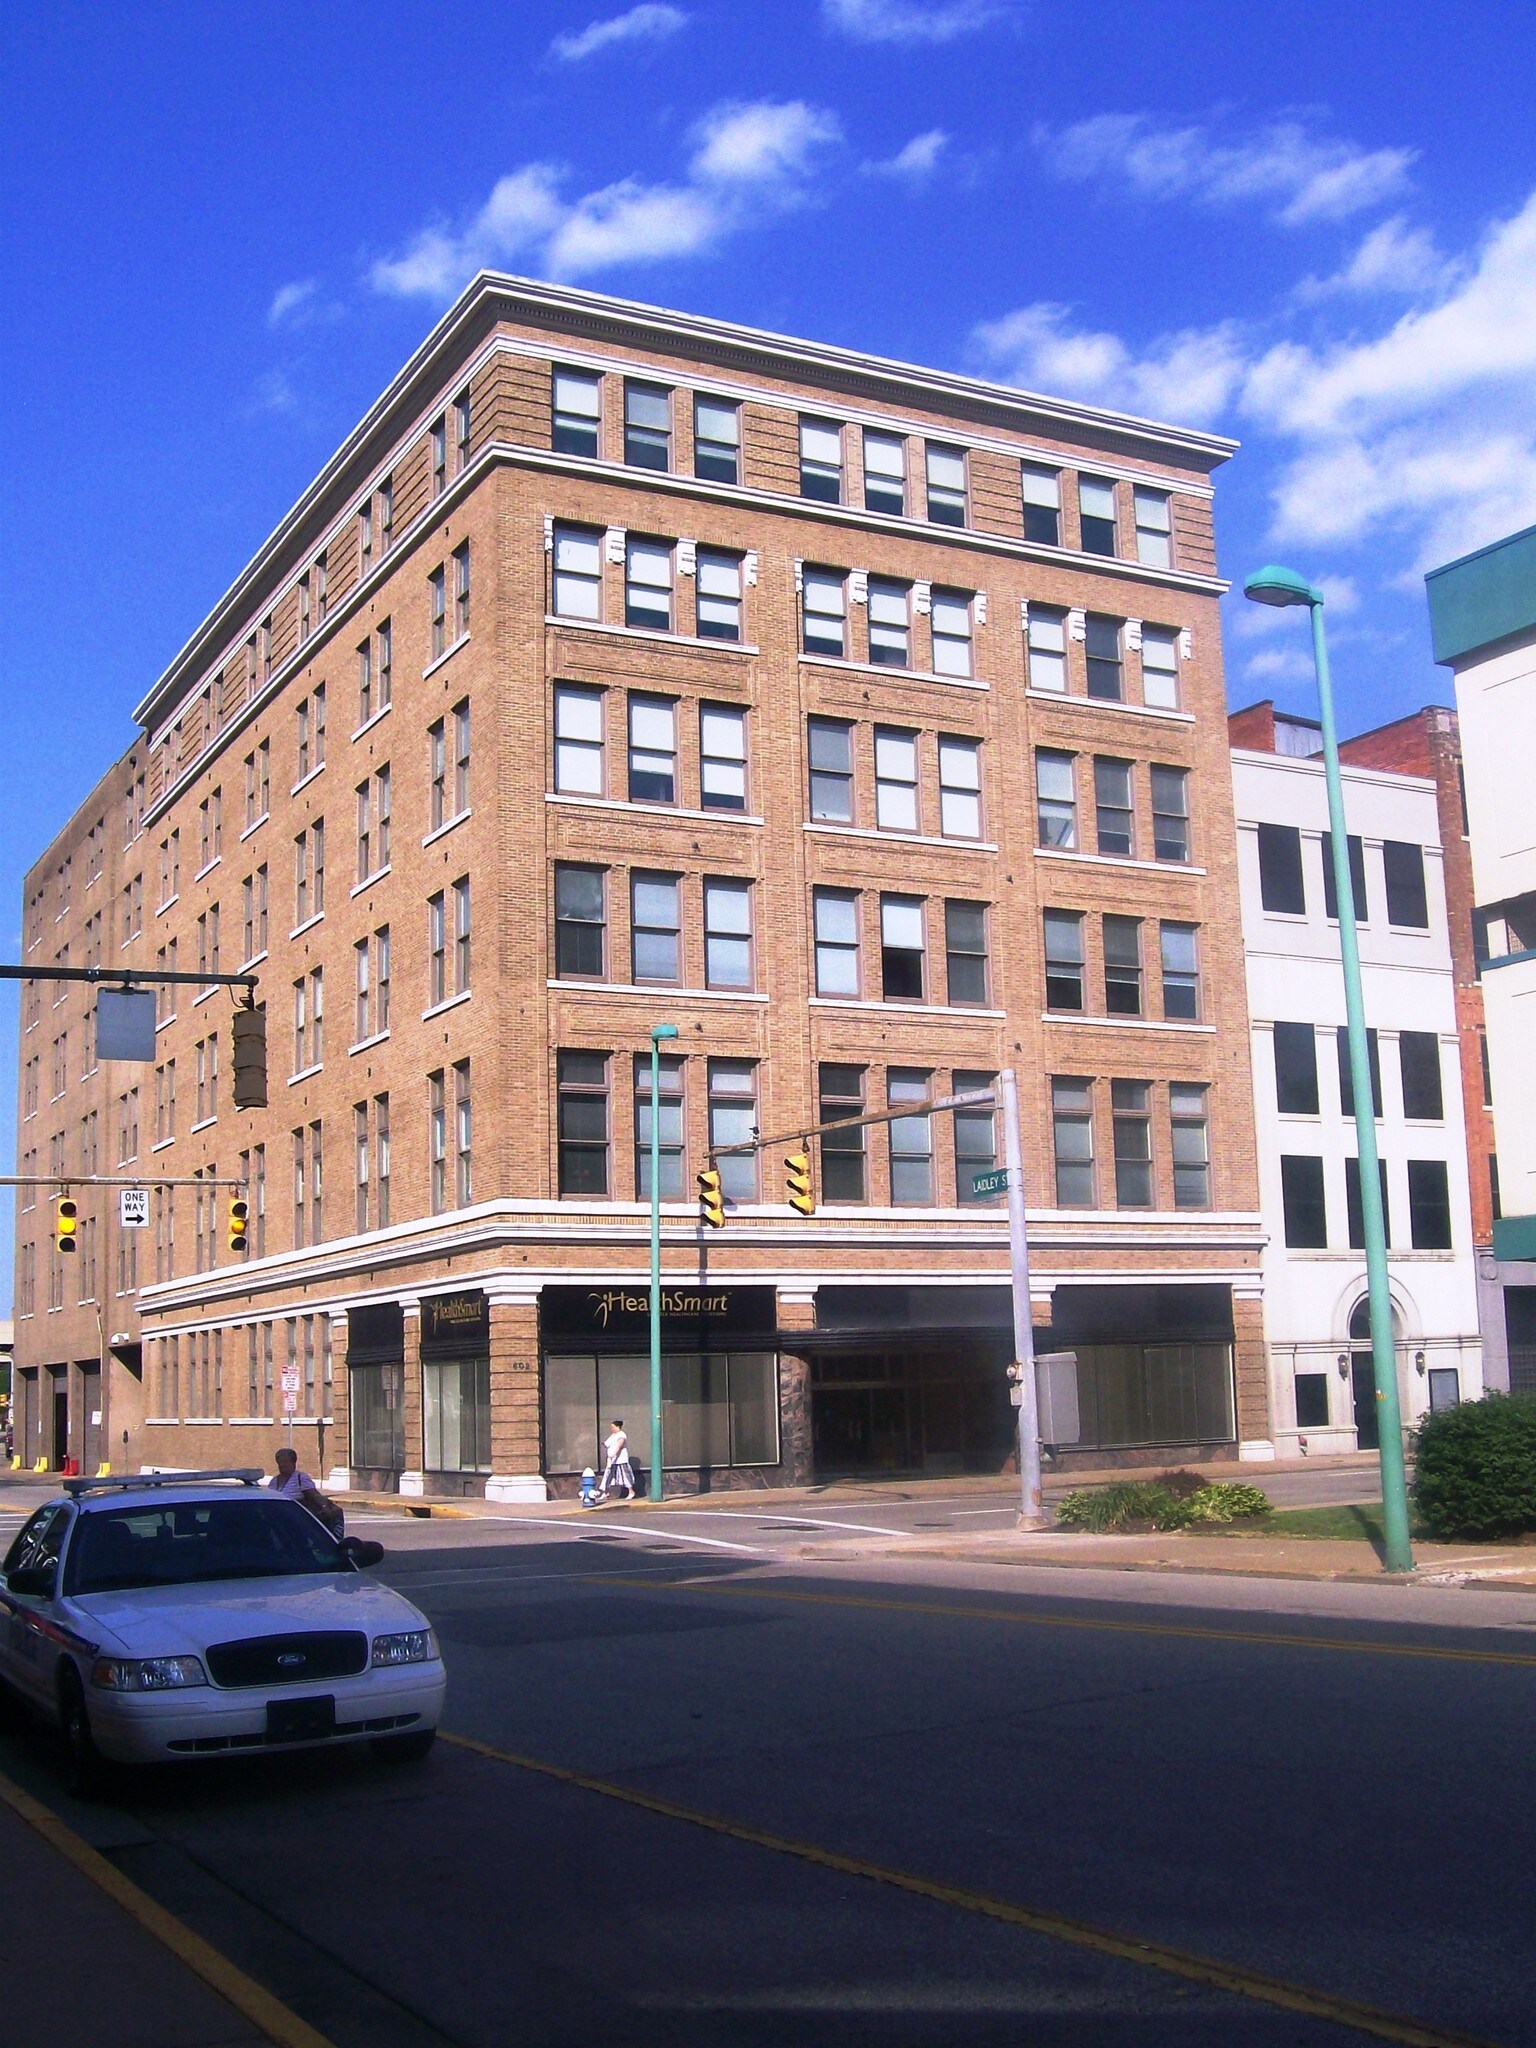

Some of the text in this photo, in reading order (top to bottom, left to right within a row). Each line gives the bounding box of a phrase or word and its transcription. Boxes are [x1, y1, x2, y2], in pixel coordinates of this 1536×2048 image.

[125, 1193, 144, 1201] ONE
[124, 1203, 145, 1211] WAY
[607, 1291, 728, 1312] HeahSmart
